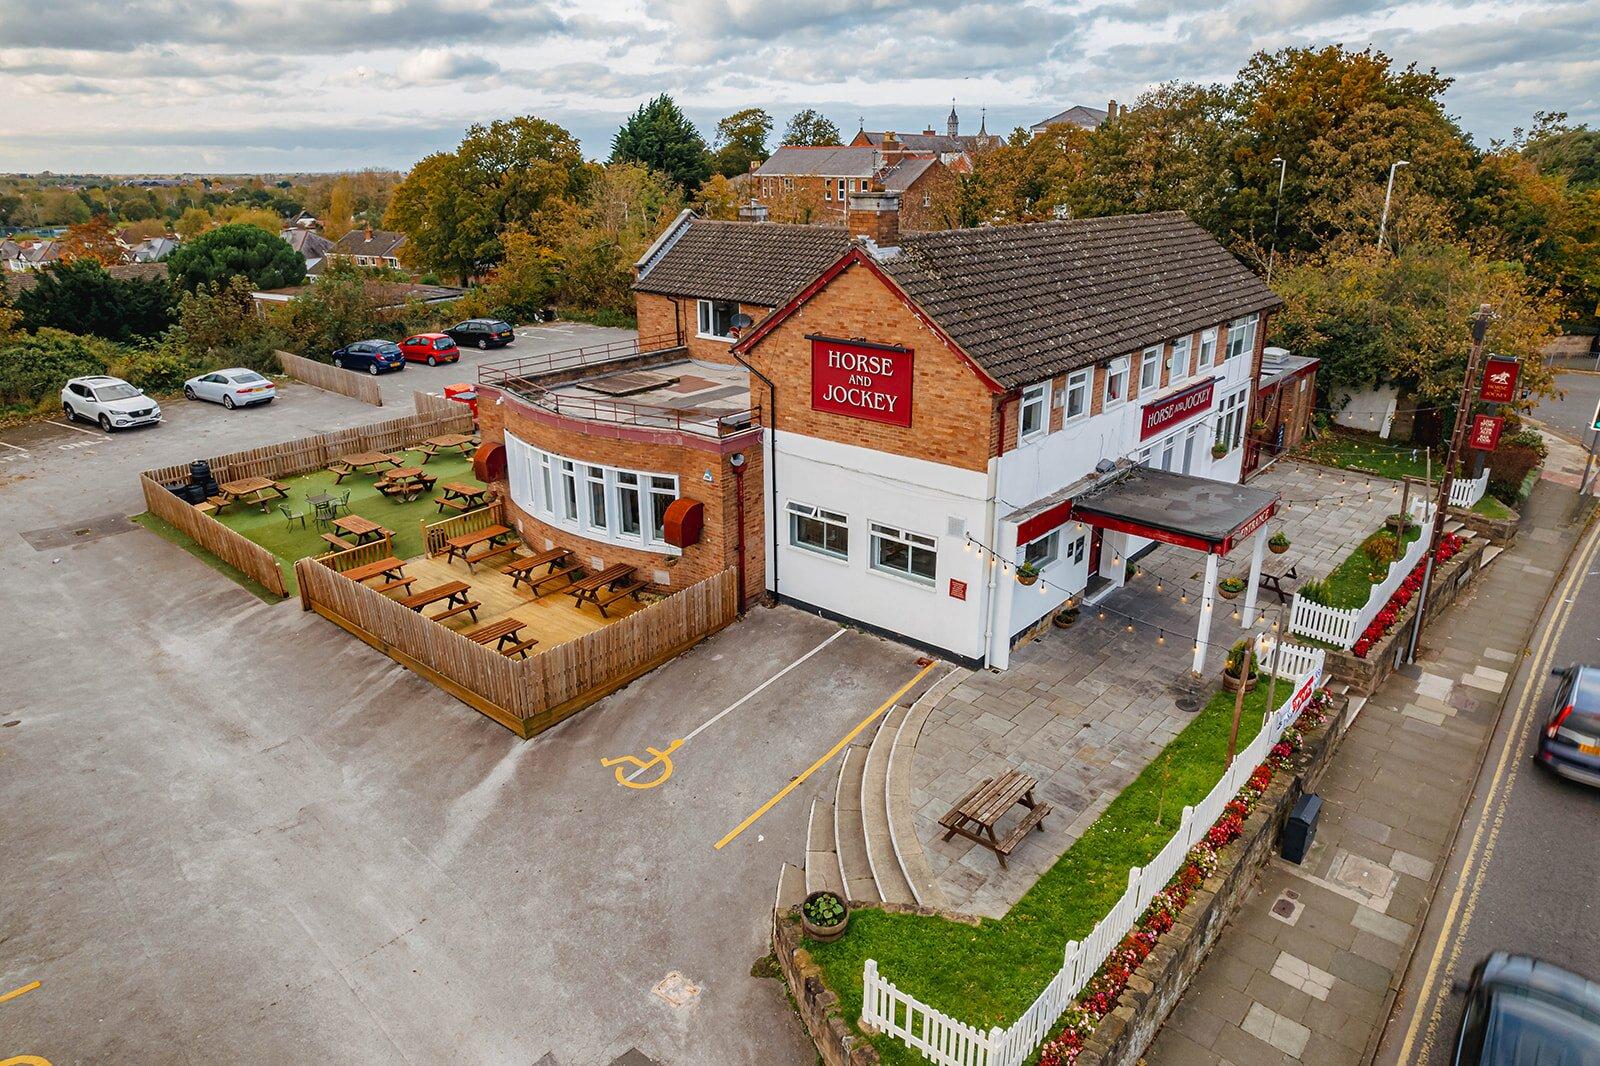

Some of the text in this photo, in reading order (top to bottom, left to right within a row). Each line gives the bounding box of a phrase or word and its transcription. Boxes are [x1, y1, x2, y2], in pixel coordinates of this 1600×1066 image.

[828, 350, 894, 376] HORSE
[848, 374, 872, 387] AND
[823, 384, 898, 412] JOCKEY
[1147, 404, 1175, 428] HORSE
[1182, 387, 1211, 411] JOCKEY
[1240, 508, 1270, 537] ENTRANCE
